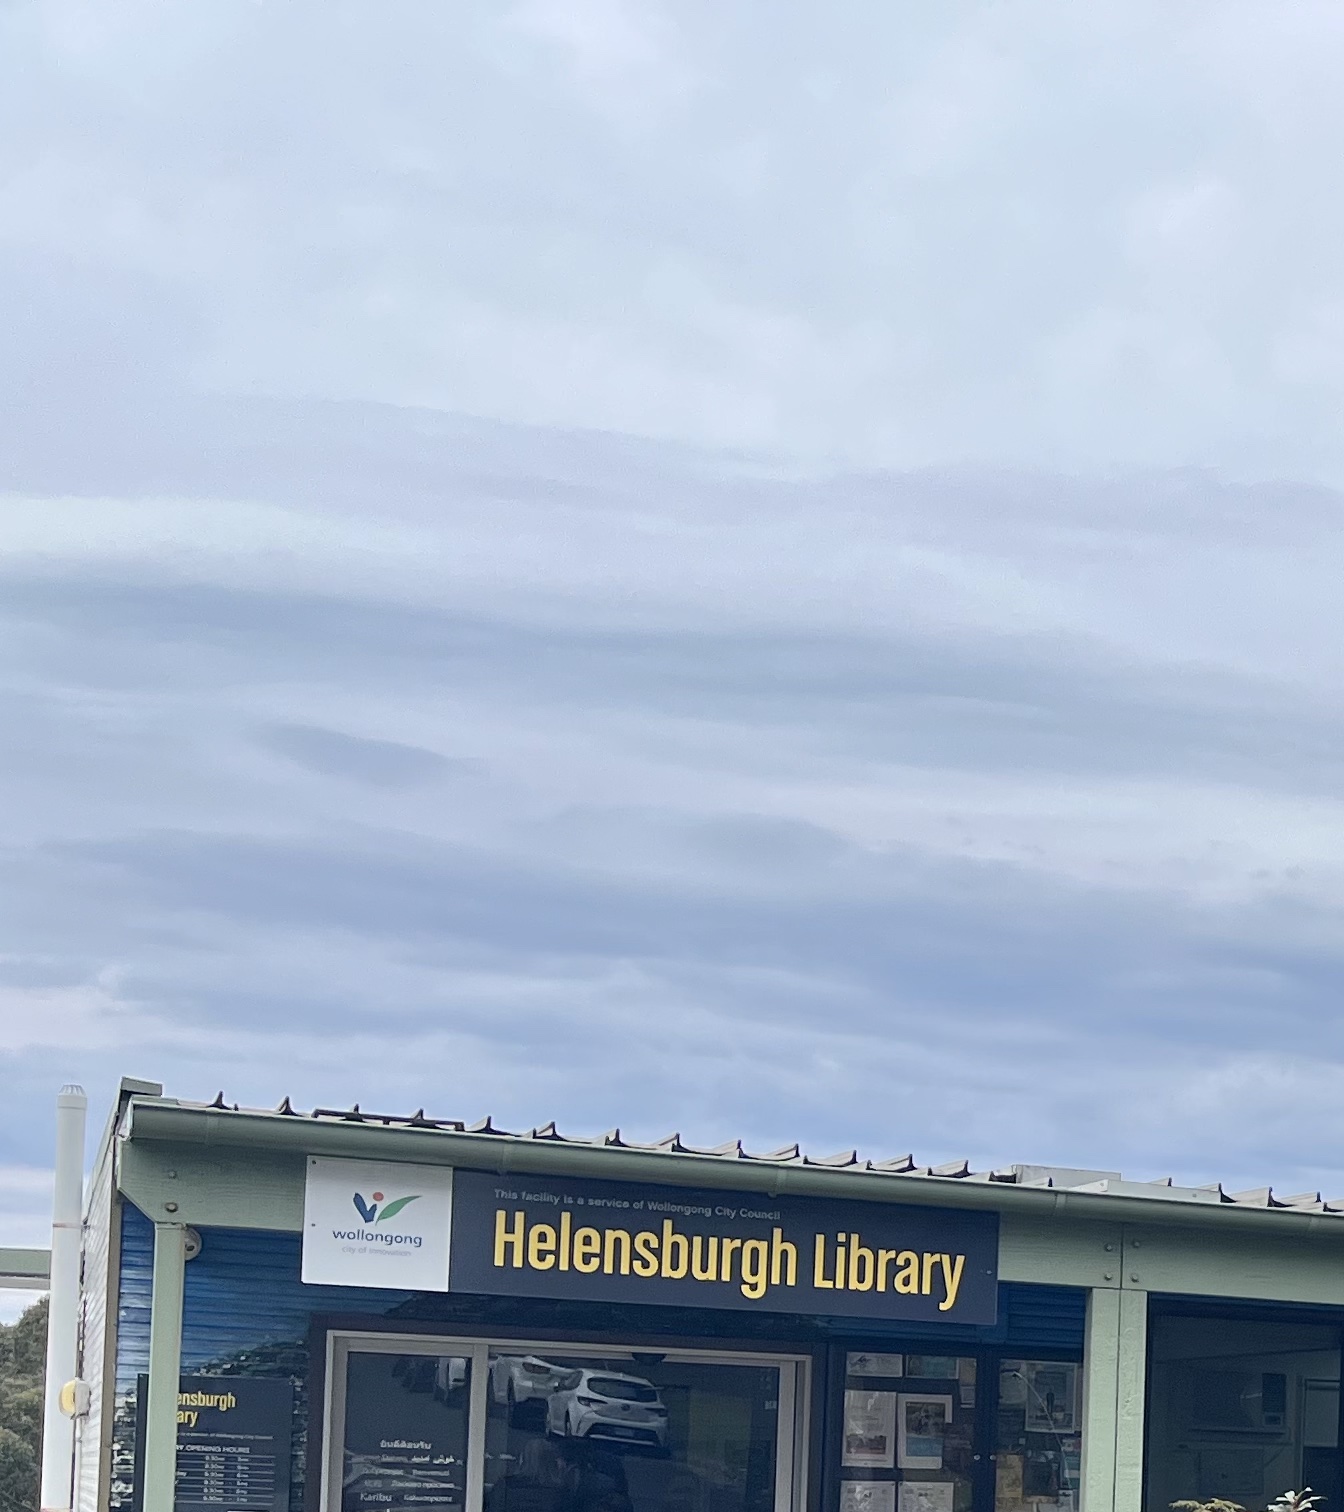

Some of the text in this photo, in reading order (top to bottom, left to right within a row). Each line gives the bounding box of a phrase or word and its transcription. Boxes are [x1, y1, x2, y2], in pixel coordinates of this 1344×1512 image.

[494, 1189, 518, 1200] This
[521, 1190, 560, 1205] facility
[563, 1194, 573, 1204] is
[588, 1197, 630, 1208] service
[633, 1200, 645, 1210] of
[648, 1200, 711, 1218] Wollongong
[715, 1206, 737, 1219] City
[740, 1208, 780, 1220] Council
[332, 1229, 422, 1248] wollongong
[342, 1246, 356, 1254] city
[493, 1210, 966, 1311] Helensburgh Library
[177, 1391, 236, 1411] ensburgh
